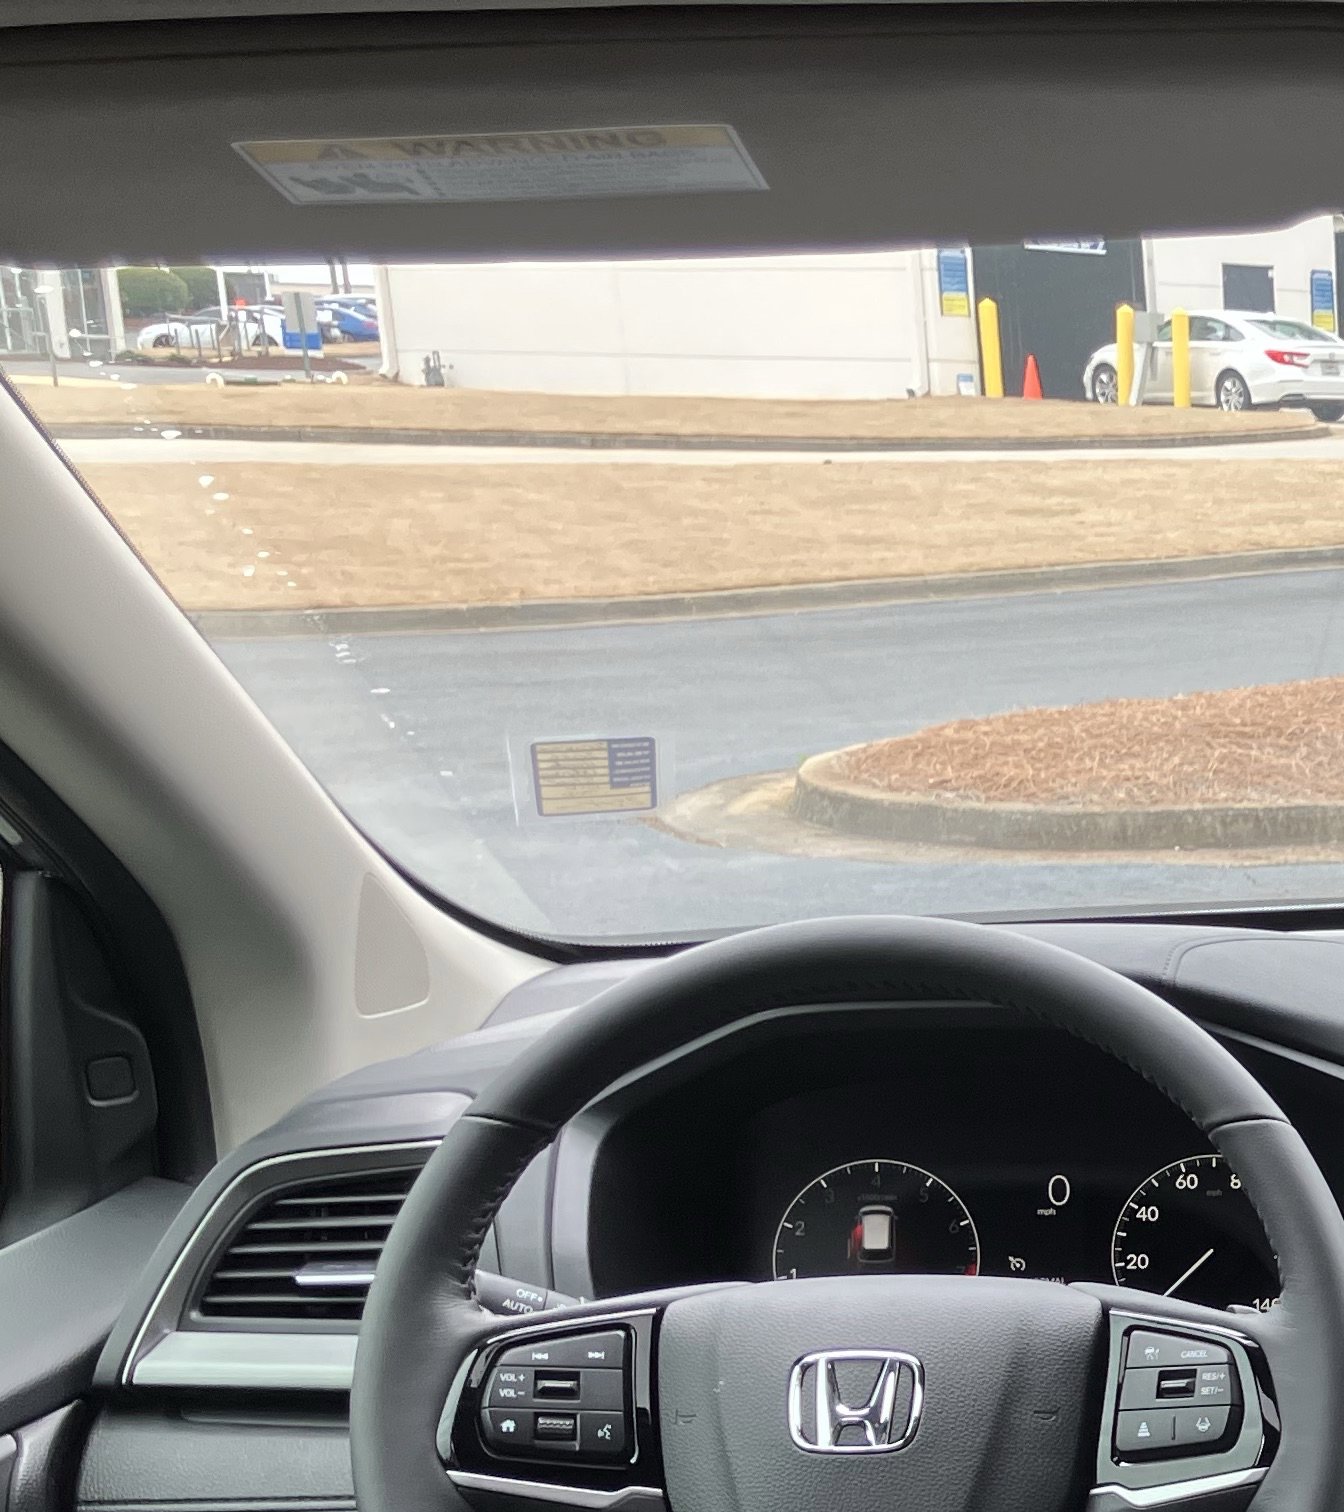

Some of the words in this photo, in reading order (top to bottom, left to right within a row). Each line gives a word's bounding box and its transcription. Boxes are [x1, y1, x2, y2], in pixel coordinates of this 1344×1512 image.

[389, 129, 667, 157] WARNING
[1175, 1173, 1199, 1190] 60
[1048, 1174, 1070, 1206] 0
[1135, 1206, 1159, 1222] 40
[795, 1221, 805, 1236] 2
[1126, 1253, 1149, 1270] 20
[516, 1289, 537, 1301] OFF
[502, 1299, 534, 1314] AUTO
[1180, 1351, 1208, 1359] CANCEL
